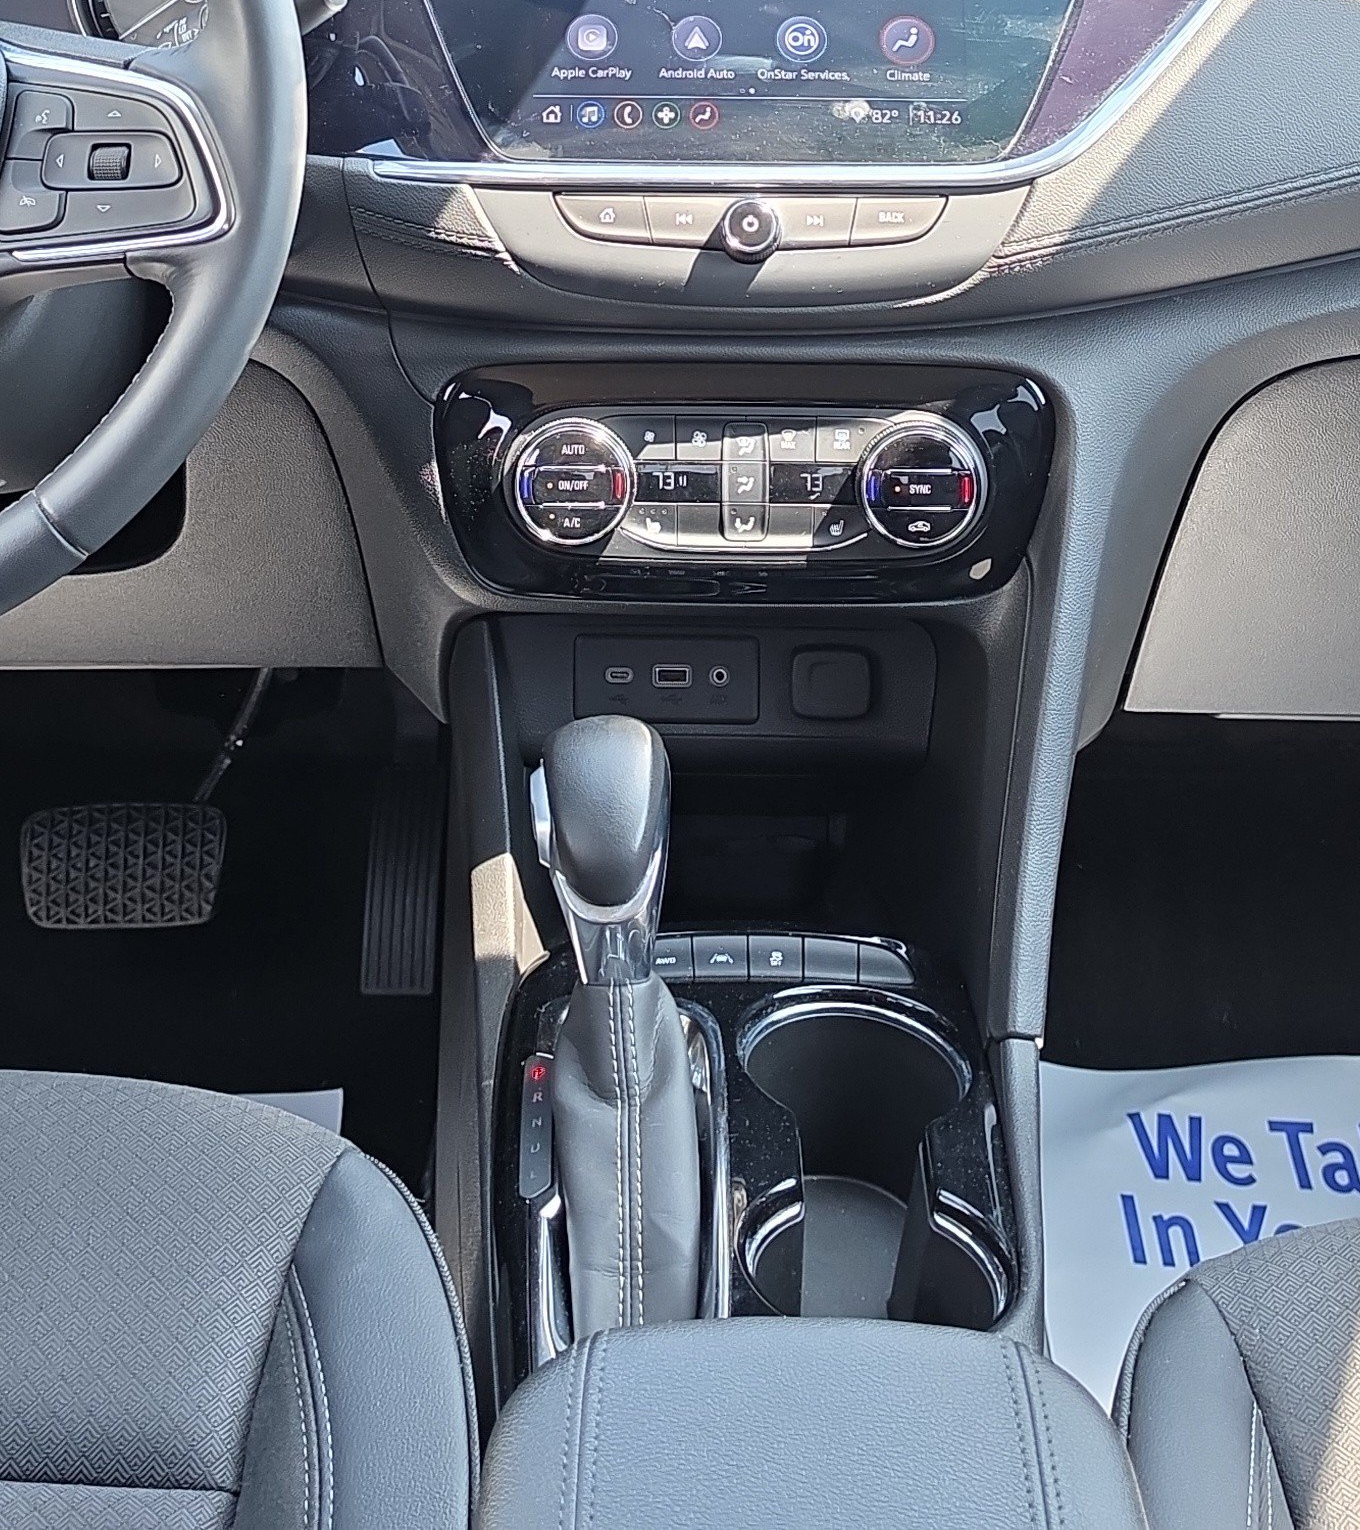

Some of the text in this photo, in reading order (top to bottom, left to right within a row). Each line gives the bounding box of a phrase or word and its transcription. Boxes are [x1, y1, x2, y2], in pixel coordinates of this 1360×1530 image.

[551, 67, 632, 80] Apple CarPlay
[659, 67, 735, 79] Android Auto
[757, 70, 798, 80] OnStar
[886, 70, 931, 81] Climate
[561, 444, 586, 455] AUTO
[557, 479, 589, 492] ON/OFF
[908, 484, 933, 495] SYNC
[563, 517, 582, 528] A/C
[654, 956, 677, 965] AWD
[532, 1091, 543, 1103] R
[531, 1116, 543, 1128] N
[1126, 1110, 1258, 1188] We
[1122, 1193, 1202, 1268] In
